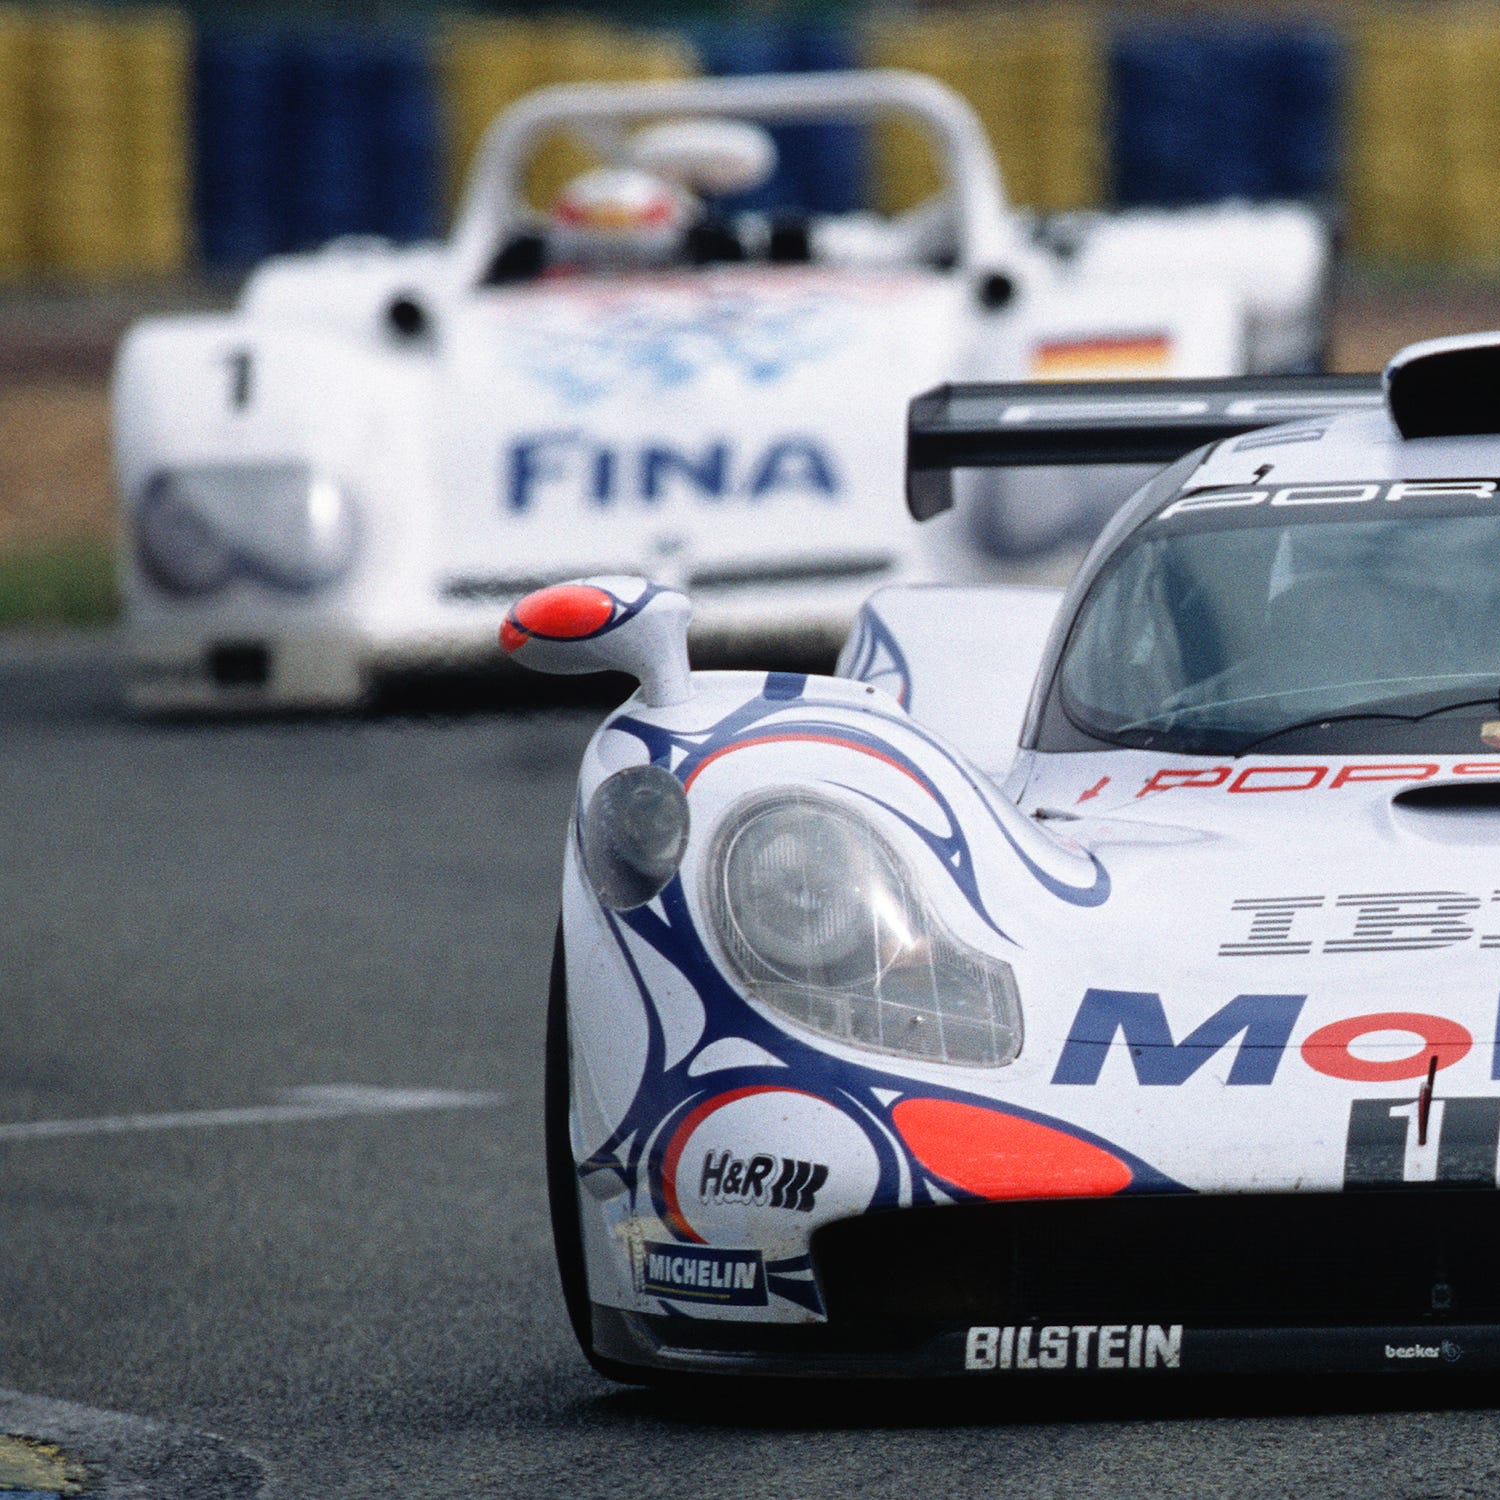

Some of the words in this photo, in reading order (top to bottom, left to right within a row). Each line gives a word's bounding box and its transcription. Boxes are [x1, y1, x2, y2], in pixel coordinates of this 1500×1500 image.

[230, 351, 252, 409] 1
[506, 428, 841, 513] FINA
[1388, 1099, 1444, 1182] 1
[700, 1150, 776, 1204] H&R
[648, 1254, 757, 1290] MICHELIN
[965, 1324, 1182, 1371] BILSTEIN
